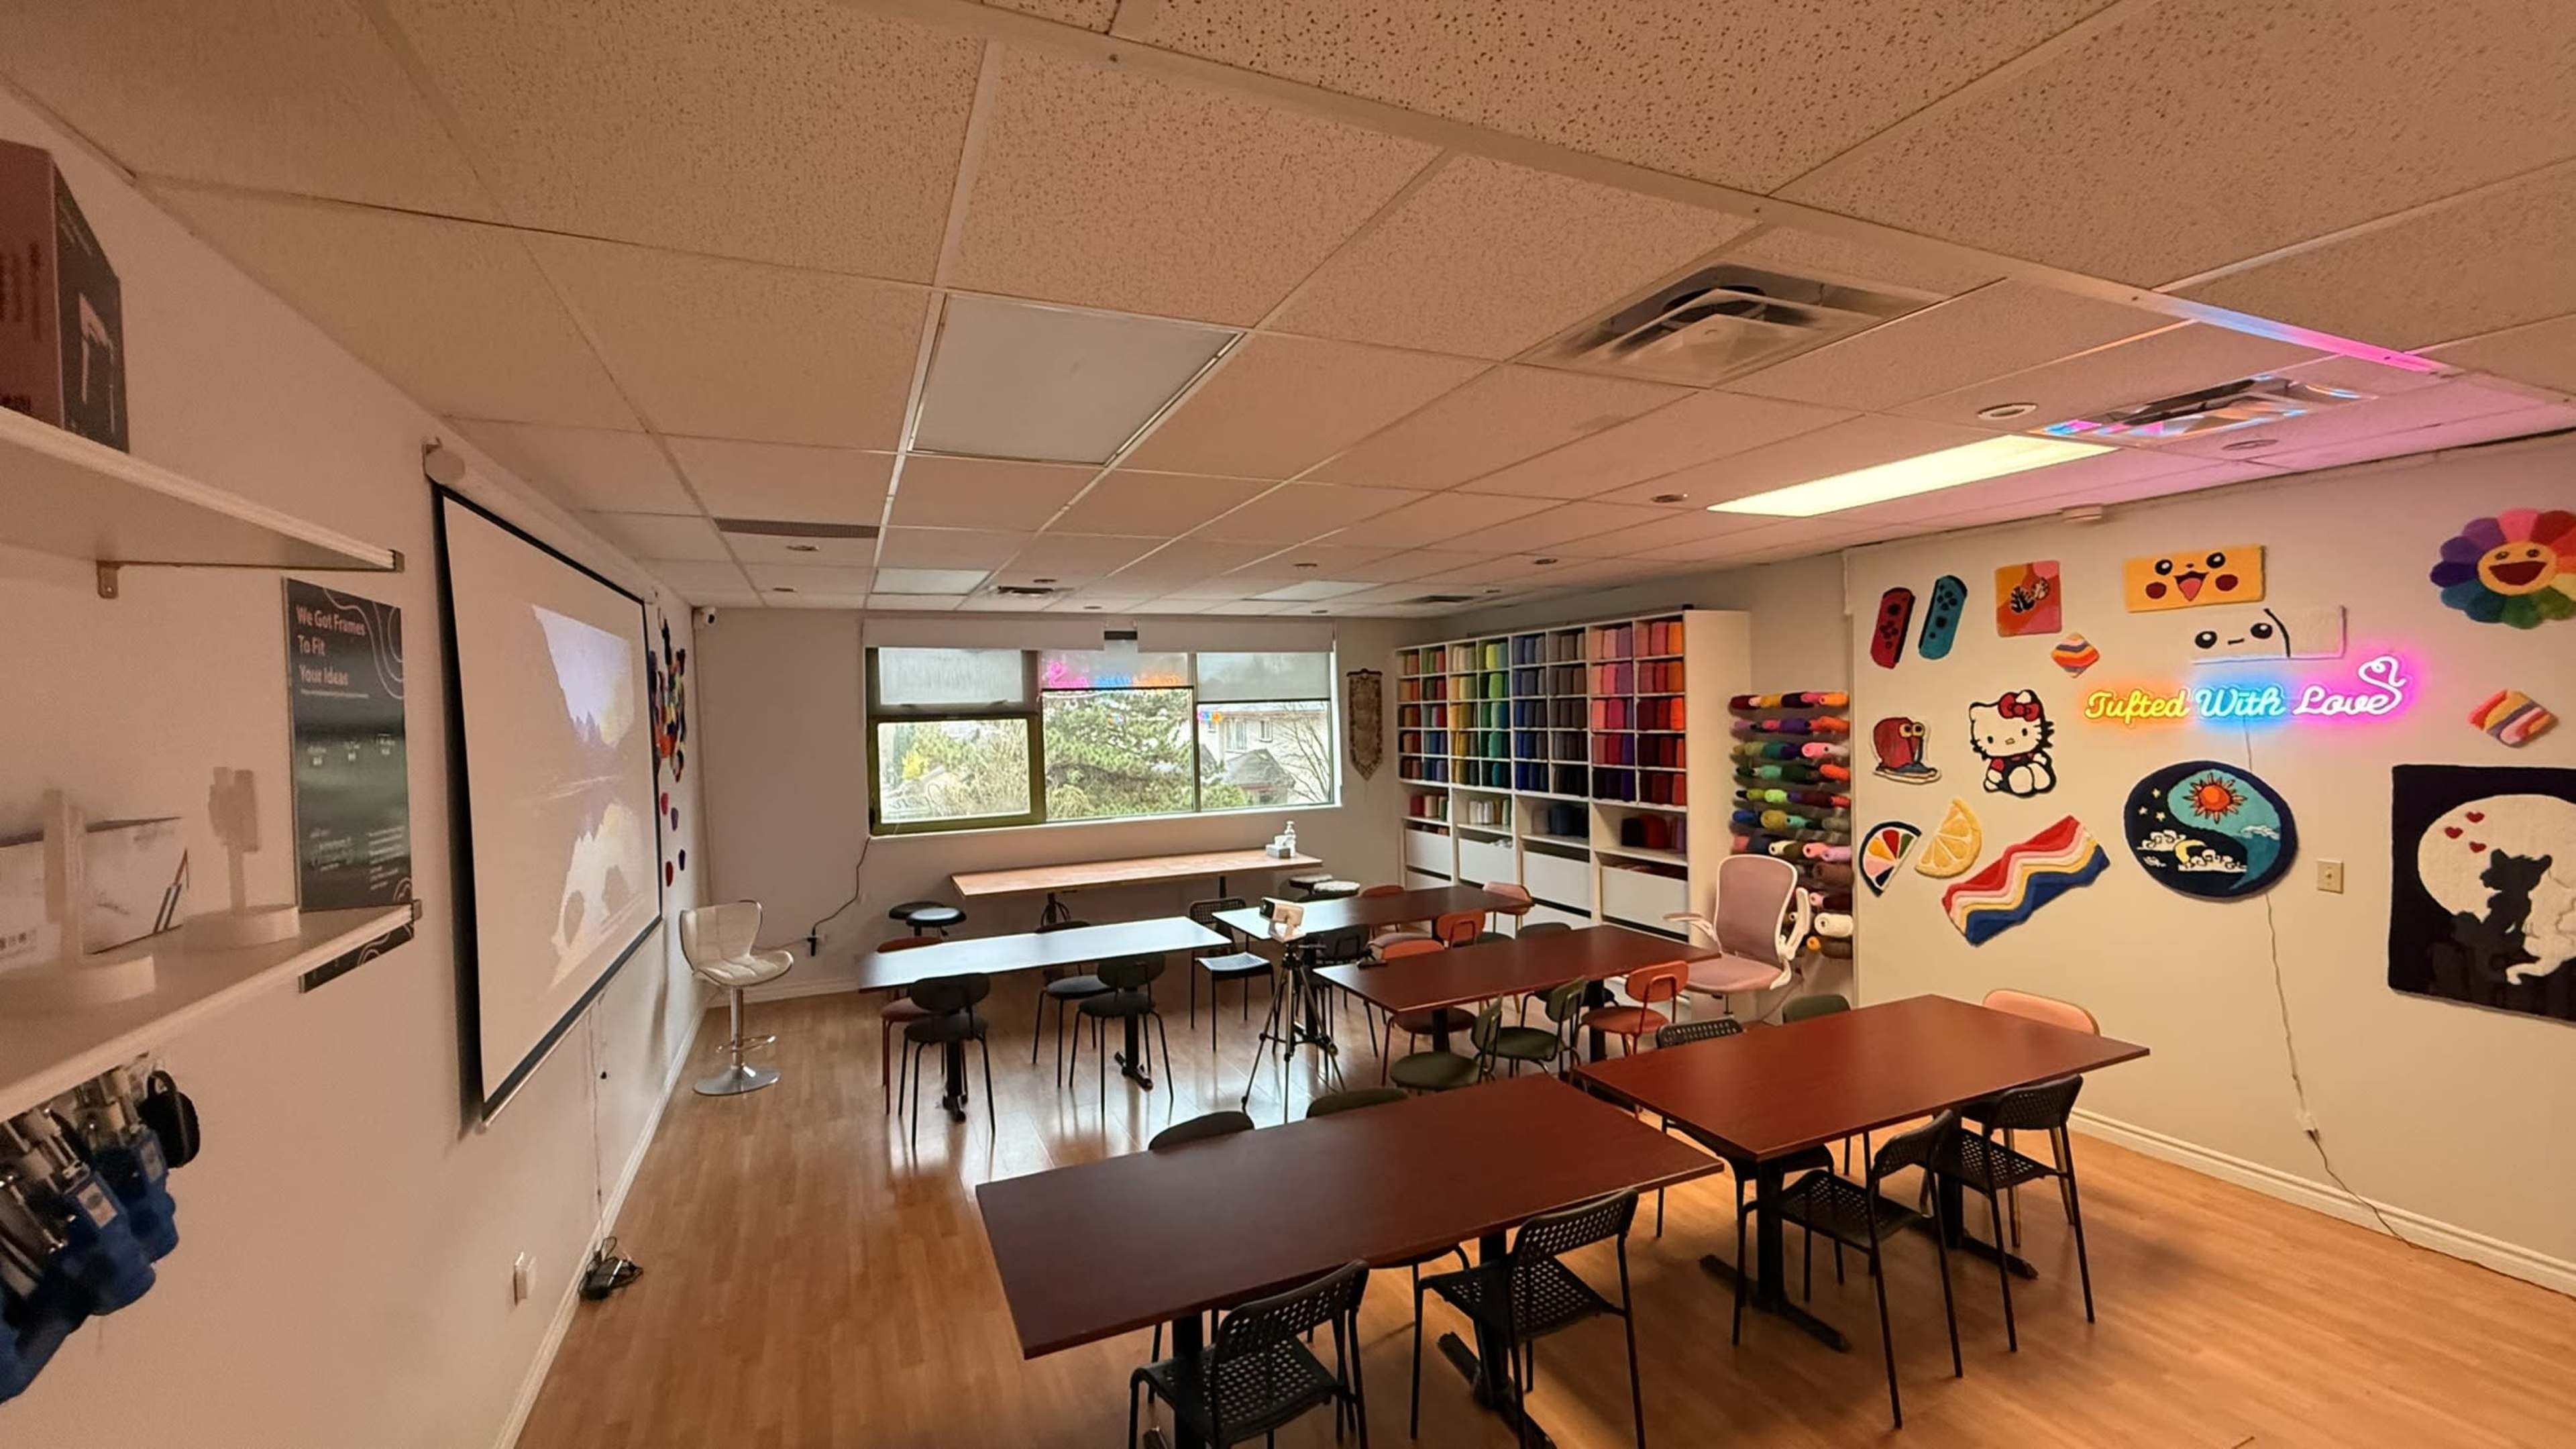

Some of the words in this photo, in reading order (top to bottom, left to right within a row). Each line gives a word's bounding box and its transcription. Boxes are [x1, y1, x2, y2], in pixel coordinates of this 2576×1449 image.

[296, 605, 313, 626] We
[314, 610, 333, 629] Got
[333, 614, 366, 636] Frames
[297, 634, 311, 655] To
[312, 637, 325, 656] Fit
[299, 664, 322, 684] Your
[324, 665, 349, 686] Ideas
[2085, 689, 2190, 724] Tufted
[2195, 685, 2286, 718] With
